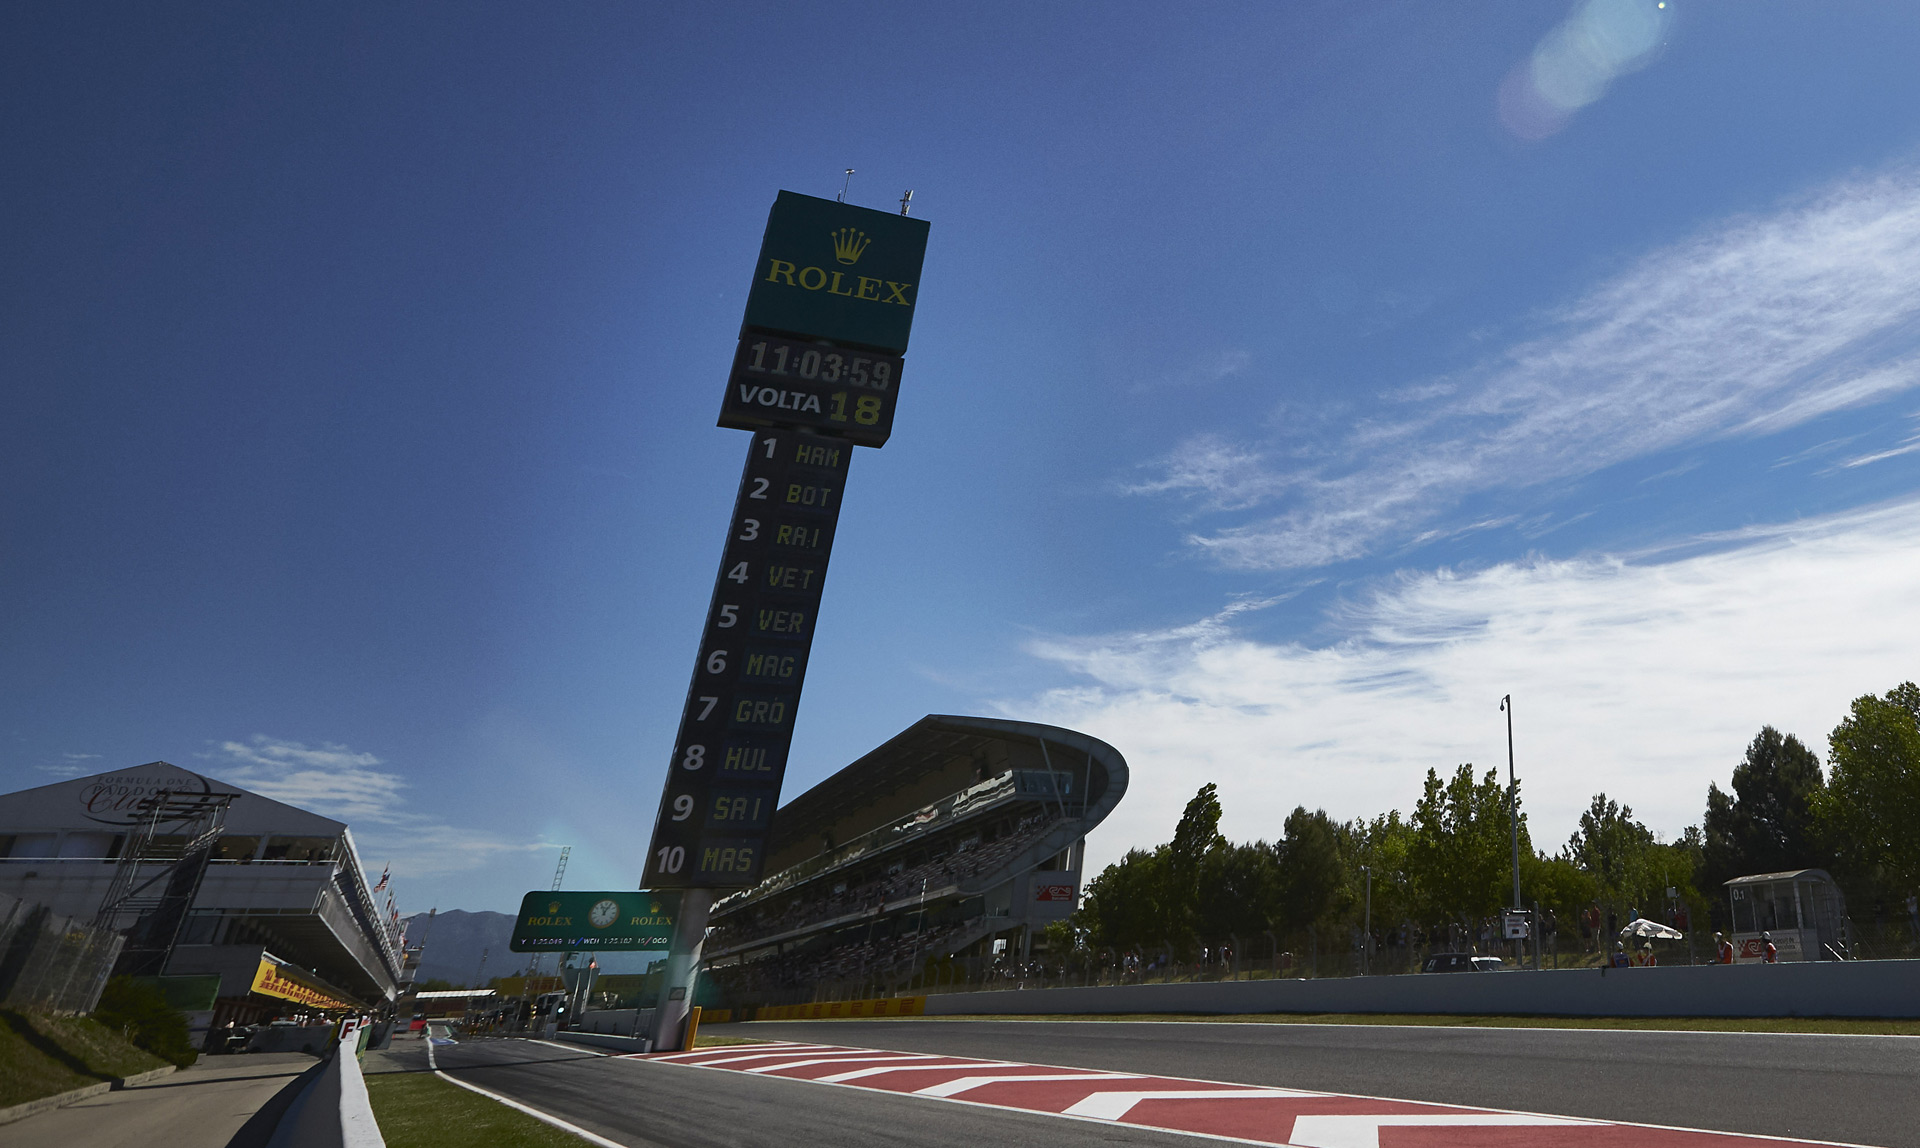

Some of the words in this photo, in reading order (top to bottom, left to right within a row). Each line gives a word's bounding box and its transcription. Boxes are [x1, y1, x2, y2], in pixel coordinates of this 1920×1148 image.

[765, 259, 912, 306] ROLEX
[749, 342, 892, 391] 11:03:59
[739, 384, 821, 413] VOLTA
[830, 391, 882, 425] 18
[763, 438, 777, 459] 1
[795, 444, 840, 468] HAM
[749, 477, 770, 500] 2
[786, 484, 831, 507] BOT
[739, 518, 760, 541] 3
[776, 524, 820, 548] RAI
[727, 561, 749, 584] 4
[768, 565, 814, 590] VET
[717, 604, 740, 628] 5
[759, 609, 804, 633] VER
[706, 650, 728, 674] 6
[746, 653, 795, 678] MAG
[696, 696, 719, 721] 7
[736, 699, 786, 724] GRO
[682, 744, 706, 771] 8
[724, 747, 772, 771] HUL
[97, 776, 161, 785] FORMULA
[671, 794, 694, 821] 9
[713, 796, 762, 821] SAI
[656, 846, 686, 874] 10
[700, 847, 753, 872] MAS
[1733, 889, 1745, 900] 0.1
[527, 916, 573, 926] ROLEX
[631, 916, 673, 926] ROLEX
[341, 1022, 356, 1039] F
